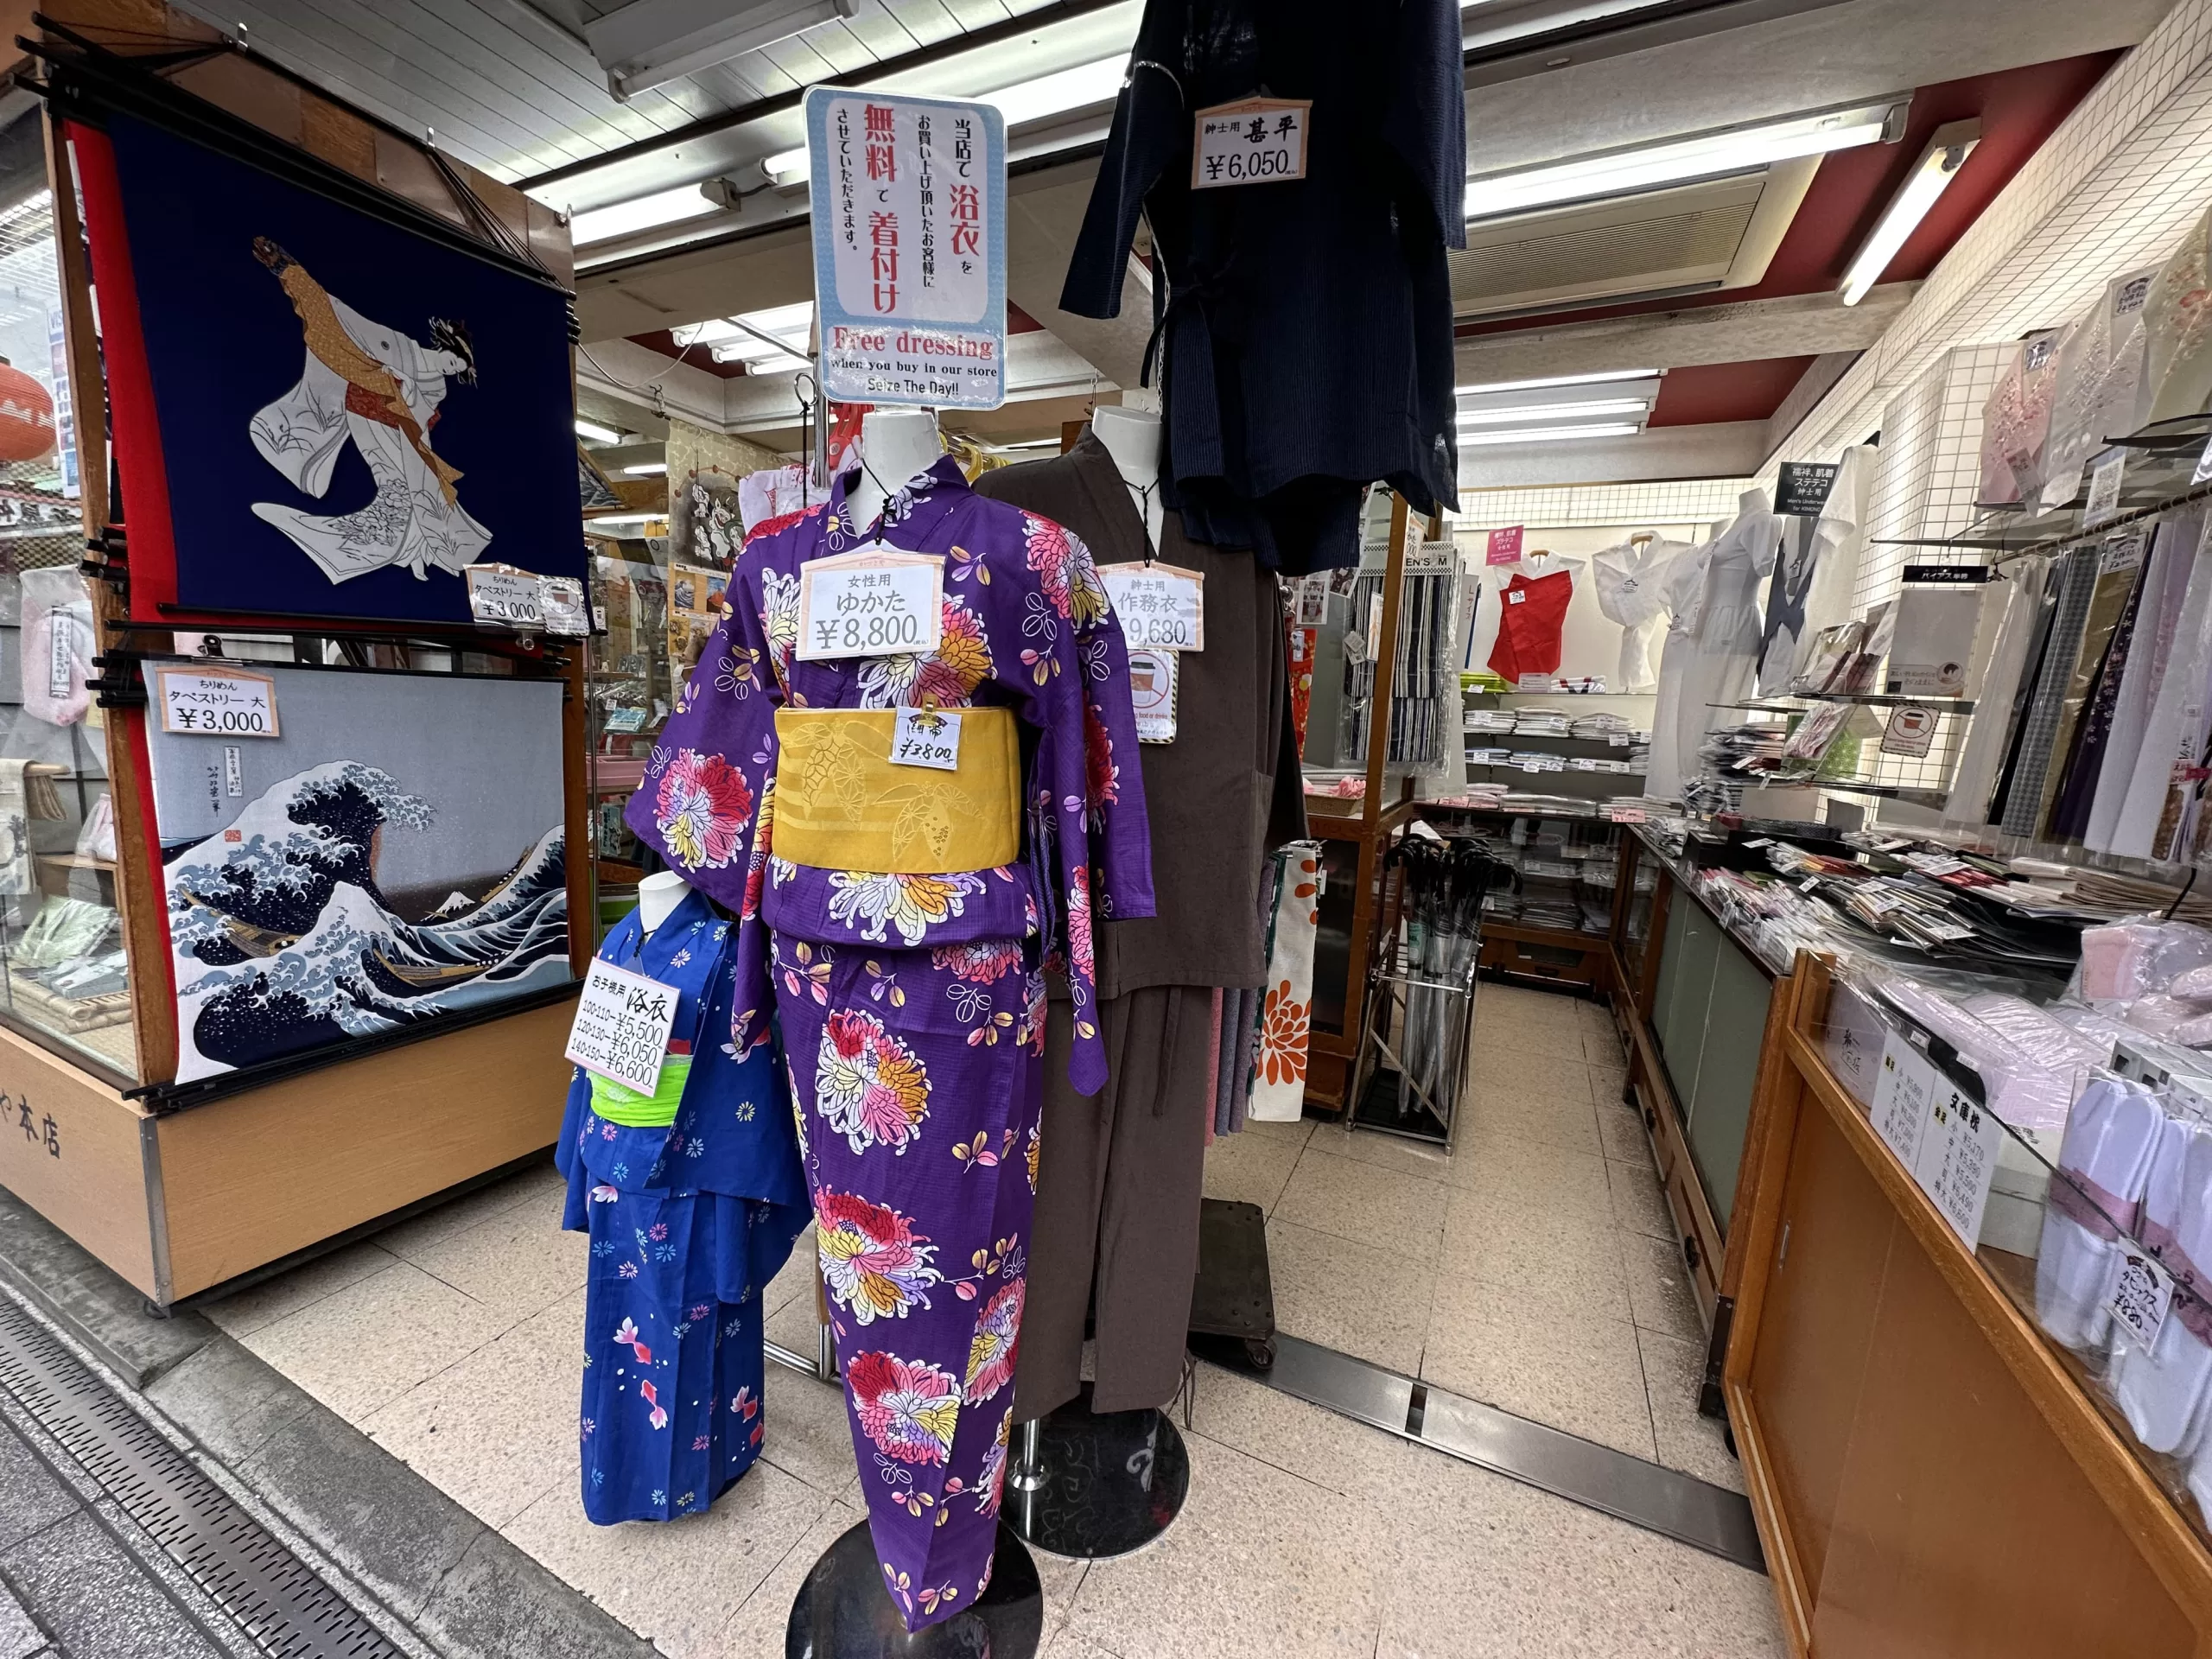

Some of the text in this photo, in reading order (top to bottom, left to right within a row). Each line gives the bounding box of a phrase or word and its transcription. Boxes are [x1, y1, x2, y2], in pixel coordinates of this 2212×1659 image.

[1205, 122, 1241, 135] 紳士用
[1205, 149, 1289, 180] ¥6,050
[833, 327, 994, 360] Free dressing
[830, 358, 997, 377] when you buy in our store
[868, 378, 959, 397] Seize The Day!!
[1795, 478, 1828, 487] ステテコ
[1797, 487, 1821, 496] 紳士用
[1404, 557, 1430, 567] EN'S
[493, 575, 518, 587] ちりめん
[848, 574, 891, 588] 女性用
[1130, 579, 1166, 592] 紳士用
[475, 583, 536, 601] タペストリー 大
[836, 589, 906, 617] ゆかた
[1117, 592, 1179, 614] 作務衣
[816, 614, 918, 650] ¥8,800
[1121, 617, 1186, 650] 9,680
[199, 679, 238, 691] ちりめん
[169, 690, 267, 709] タペストリー 大
[176, 708, 264, 733] ¥3,000
[592, 975, 669, 1023] お子様用 浴衣
